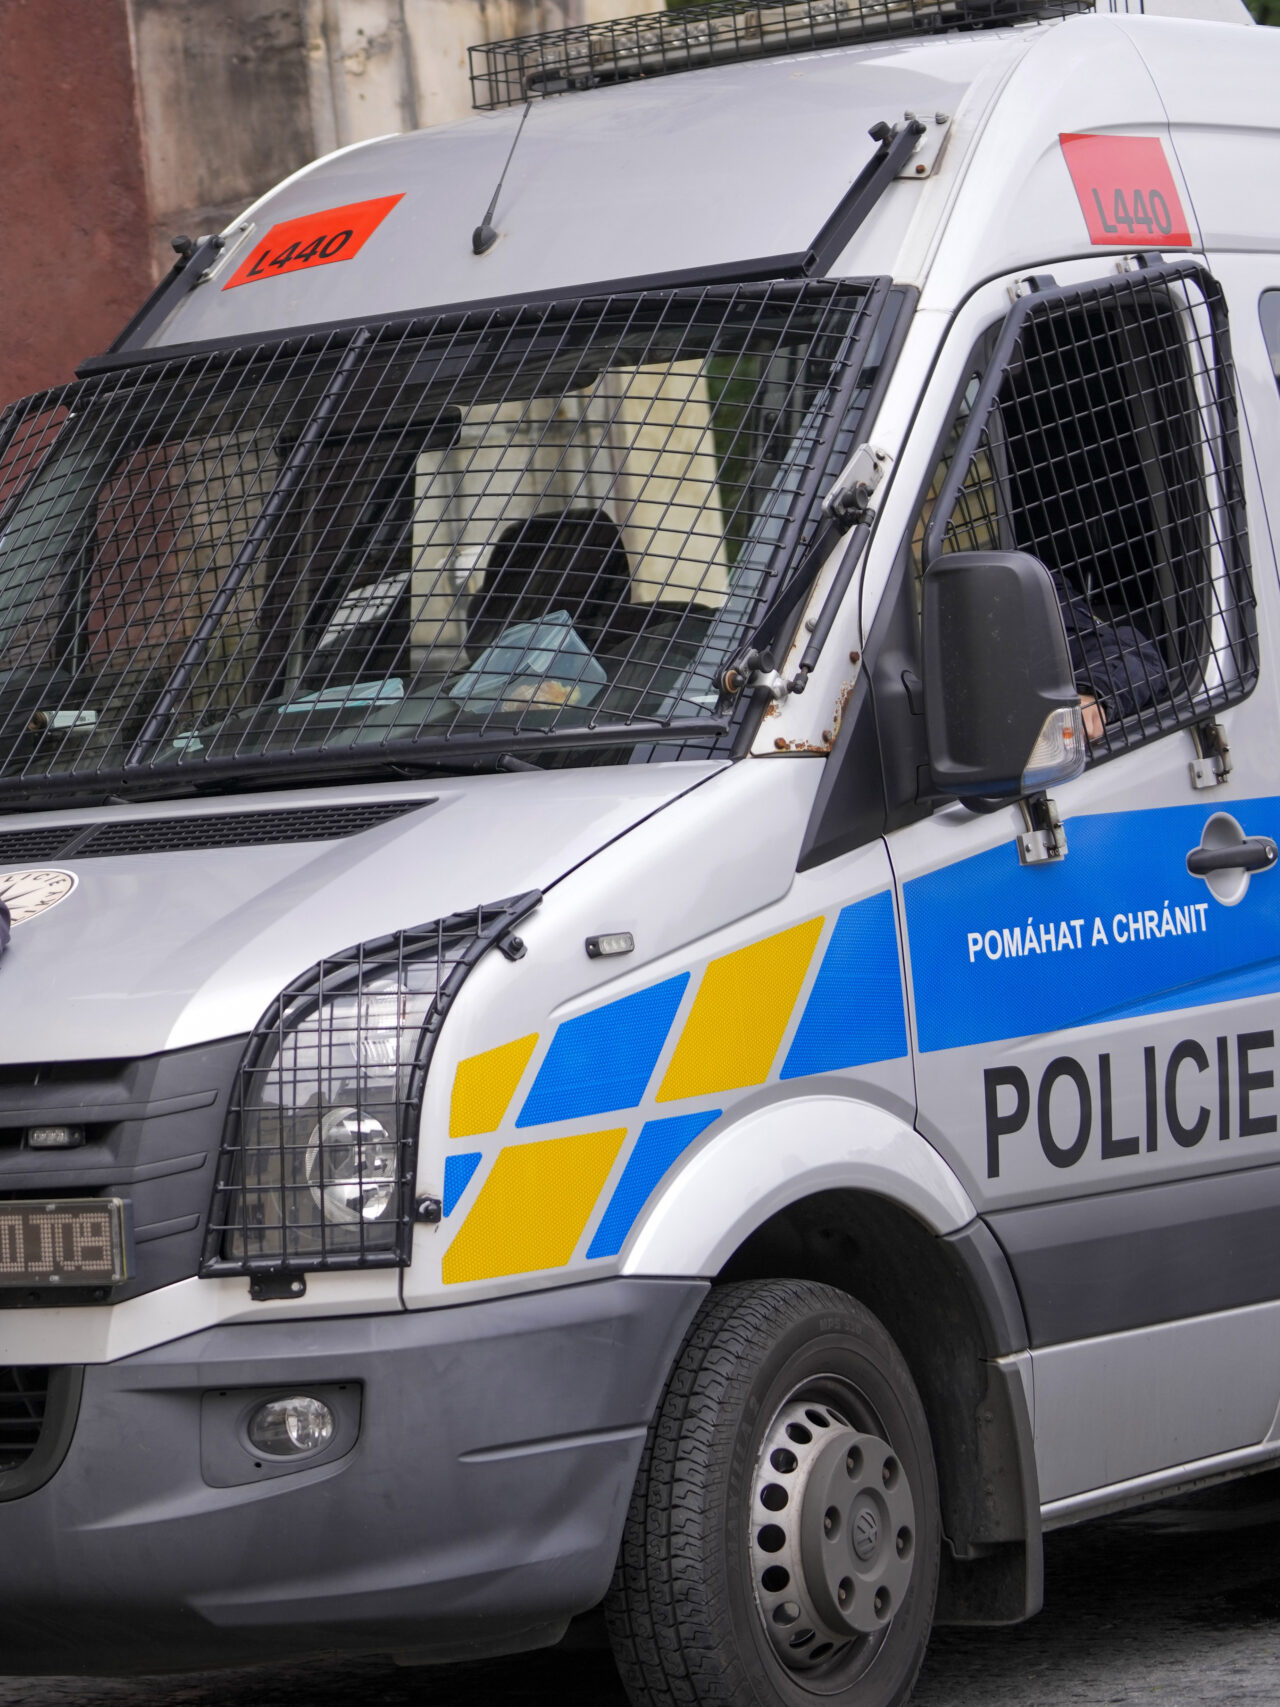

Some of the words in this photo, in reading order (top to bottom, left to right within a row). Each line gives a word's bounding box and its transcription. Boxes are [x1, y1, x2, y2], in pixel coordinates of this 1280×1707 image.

[1091, 187, 1172, 235] L440
[245, 229, 354, 278] L440
[3, 872, 66, 888] LICIE
[967, 916, 1085, 963] POMÁHAT
[1091, 916, 1109, 947] A
[1112, 899, 1209, 944] CHRÁNIT
[983, 1029, 1278, 1179] POLICIE
